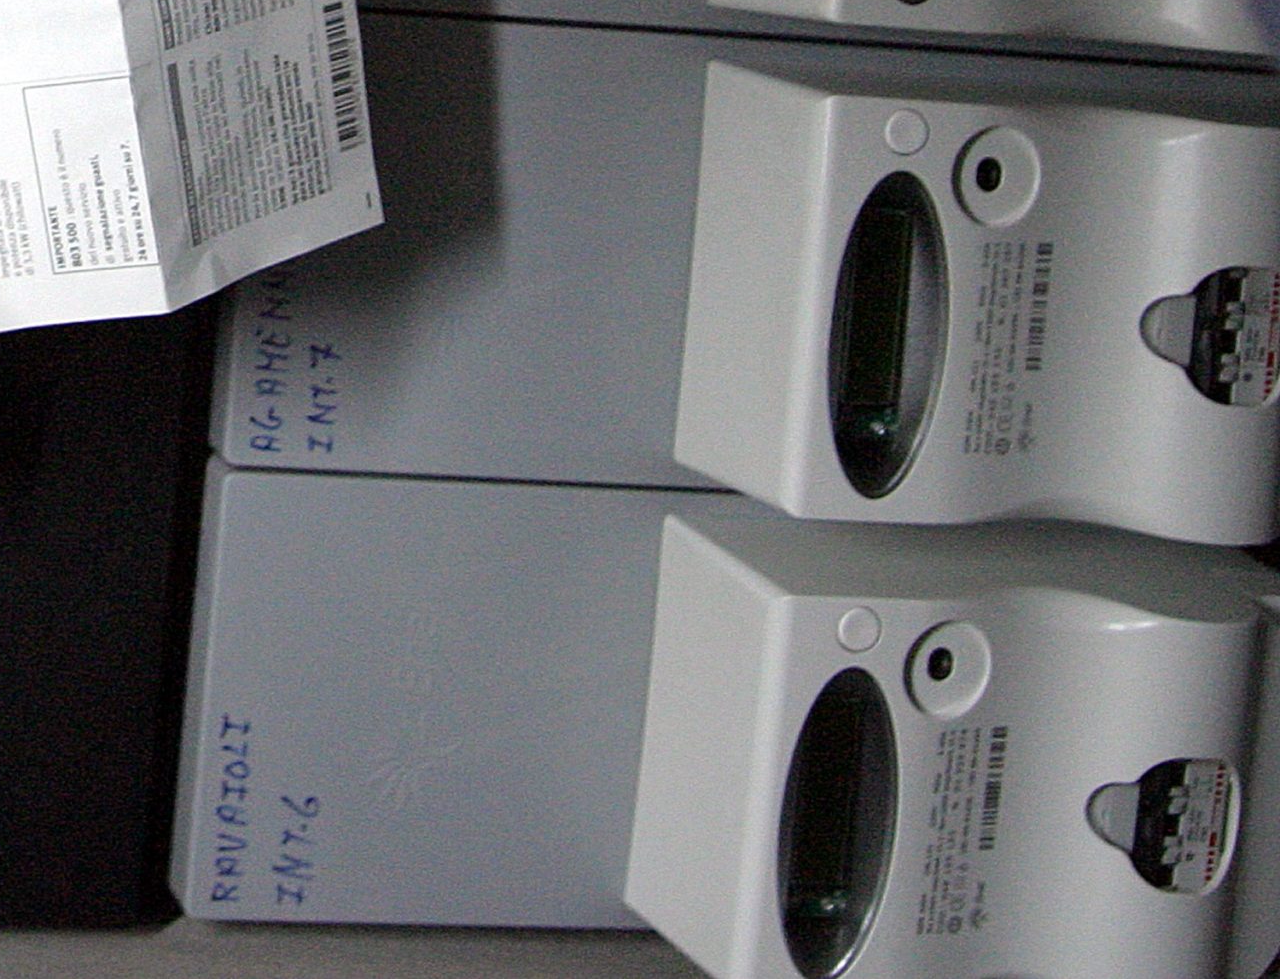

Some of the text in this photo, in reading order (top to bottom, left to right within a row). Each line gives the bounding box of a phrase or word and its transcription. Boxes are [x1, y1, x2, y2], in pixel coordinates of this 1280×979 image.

[46, 205, 67, 270] IMPORTANTE
[65, 221, 79, 244] 500
[94, 188, 116, 253] segnalazione
[69, 245, 83, 268] 803
